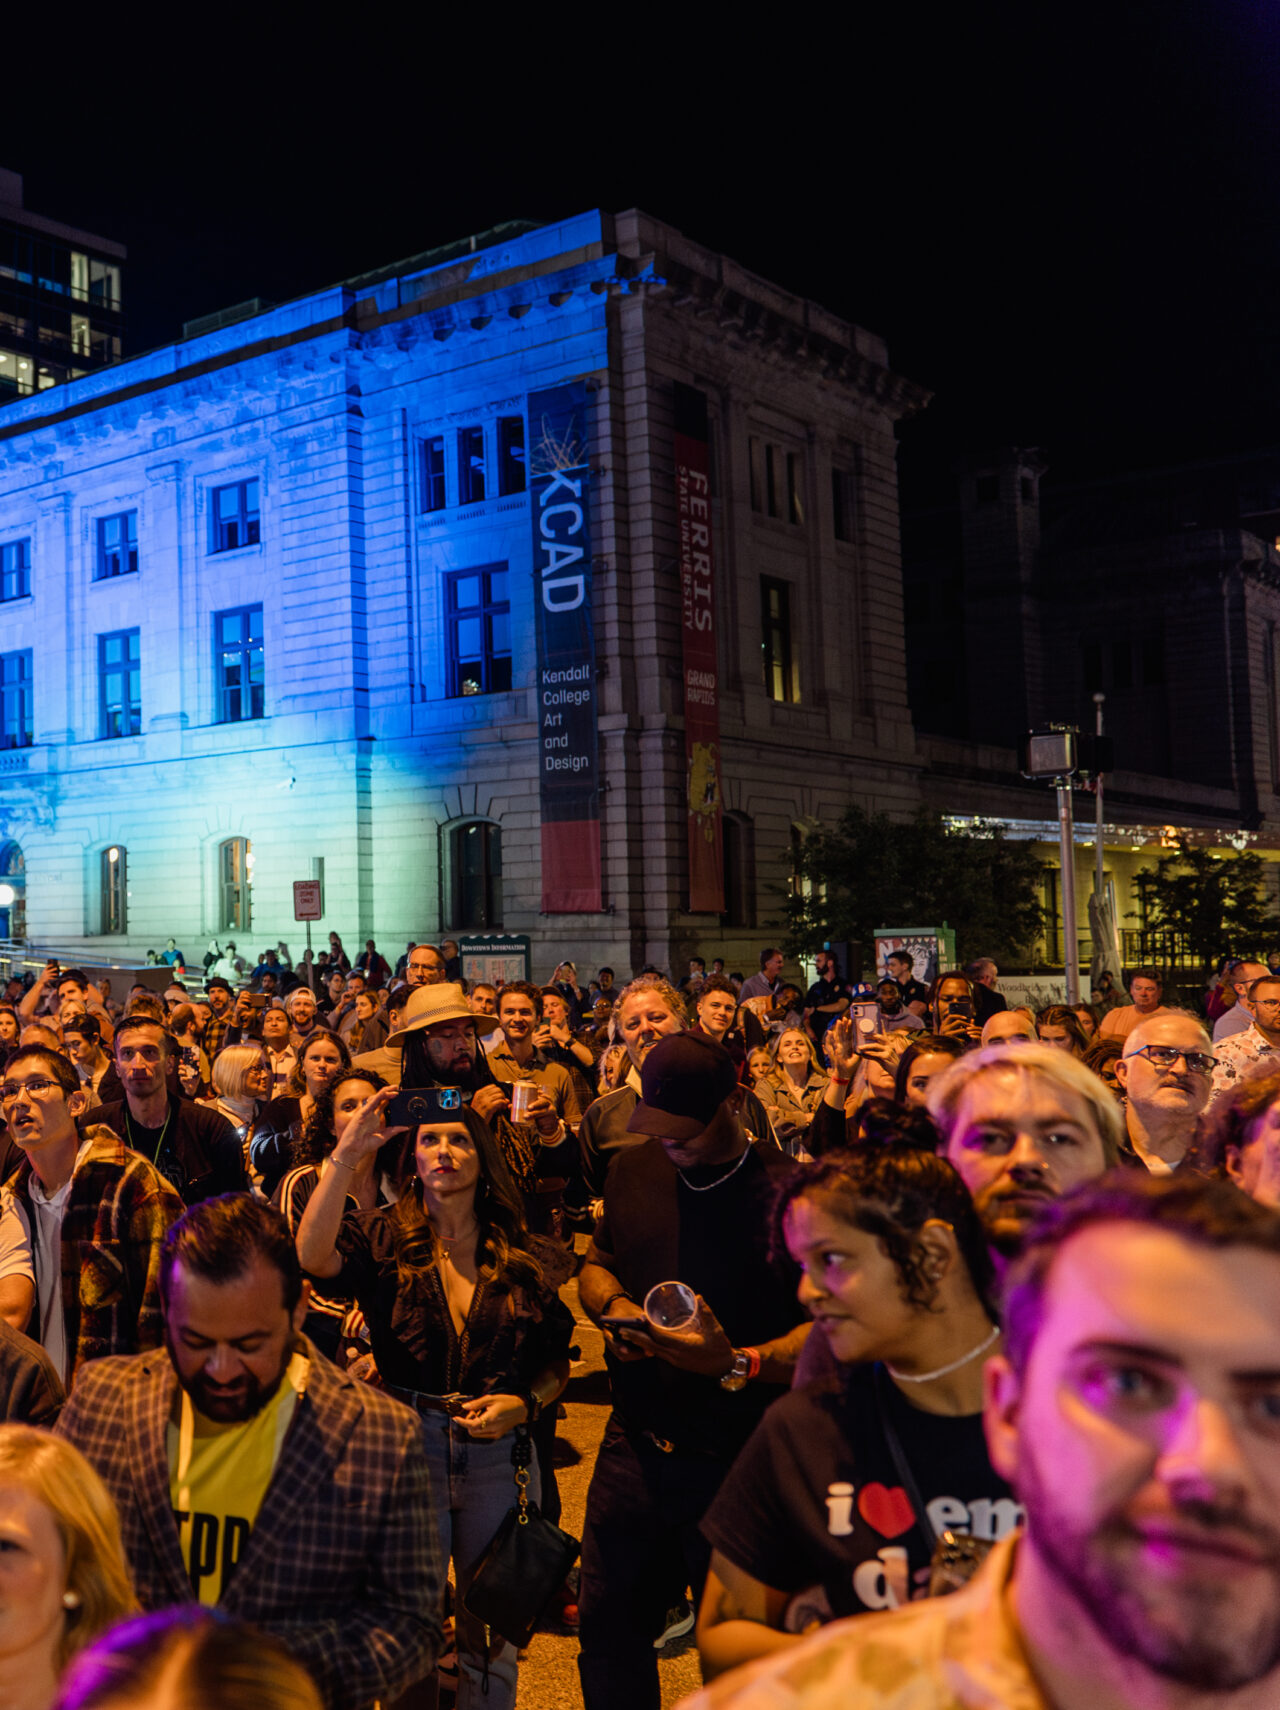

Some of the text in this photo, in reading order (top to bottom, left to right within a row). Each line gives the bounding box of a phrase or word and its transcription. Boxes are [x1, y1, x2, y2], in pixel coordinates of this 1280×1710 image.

[539, 471, 586, 613] KCAD
[678, 464, 694, 631] STATE UNIVERSITY
[688, 469, 712, 633] FERRIS
[542, 664, 590, 685] Kendall
[687, 669, 716, 689] GRAND
[543, 689, 590, 706] College
[687, 687, 716, 706] RAPIDS
[543, 712, 563, 727] Art
[544, 732, 569, 749] and
[545, 755, 589, 772] Design
[824, 1481, 855, 1536] i
